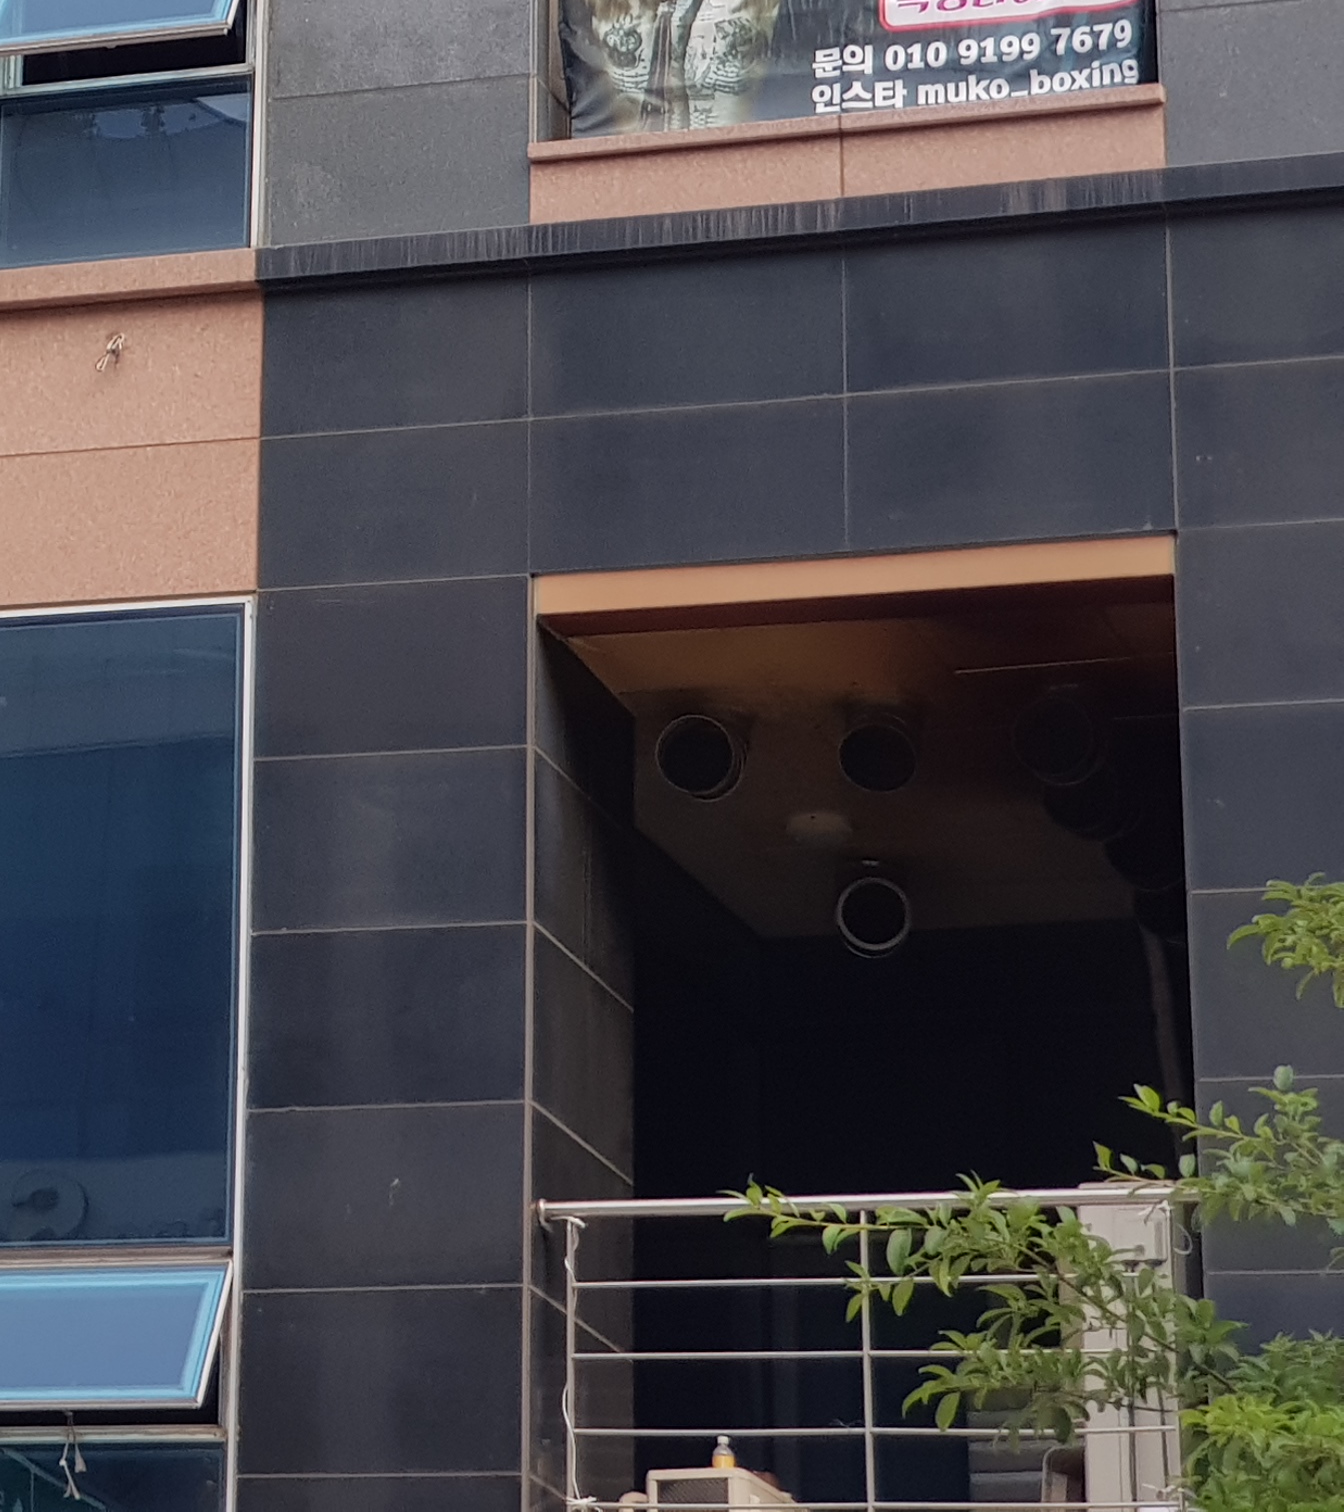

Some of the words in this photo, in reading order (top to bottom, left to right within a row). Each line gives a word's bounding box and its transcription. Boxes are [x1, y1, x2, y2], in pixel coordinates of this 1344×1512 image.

[812, 44, 874, 78] 문의
[884, 41, 948, 71] 010
[958, 32, 1040, 65] 9199
[1050, 19, 1133, 56] 7679
[812, 78, 907, 113] 인스타
[916, 58, 1139, 106] muko_boxing
